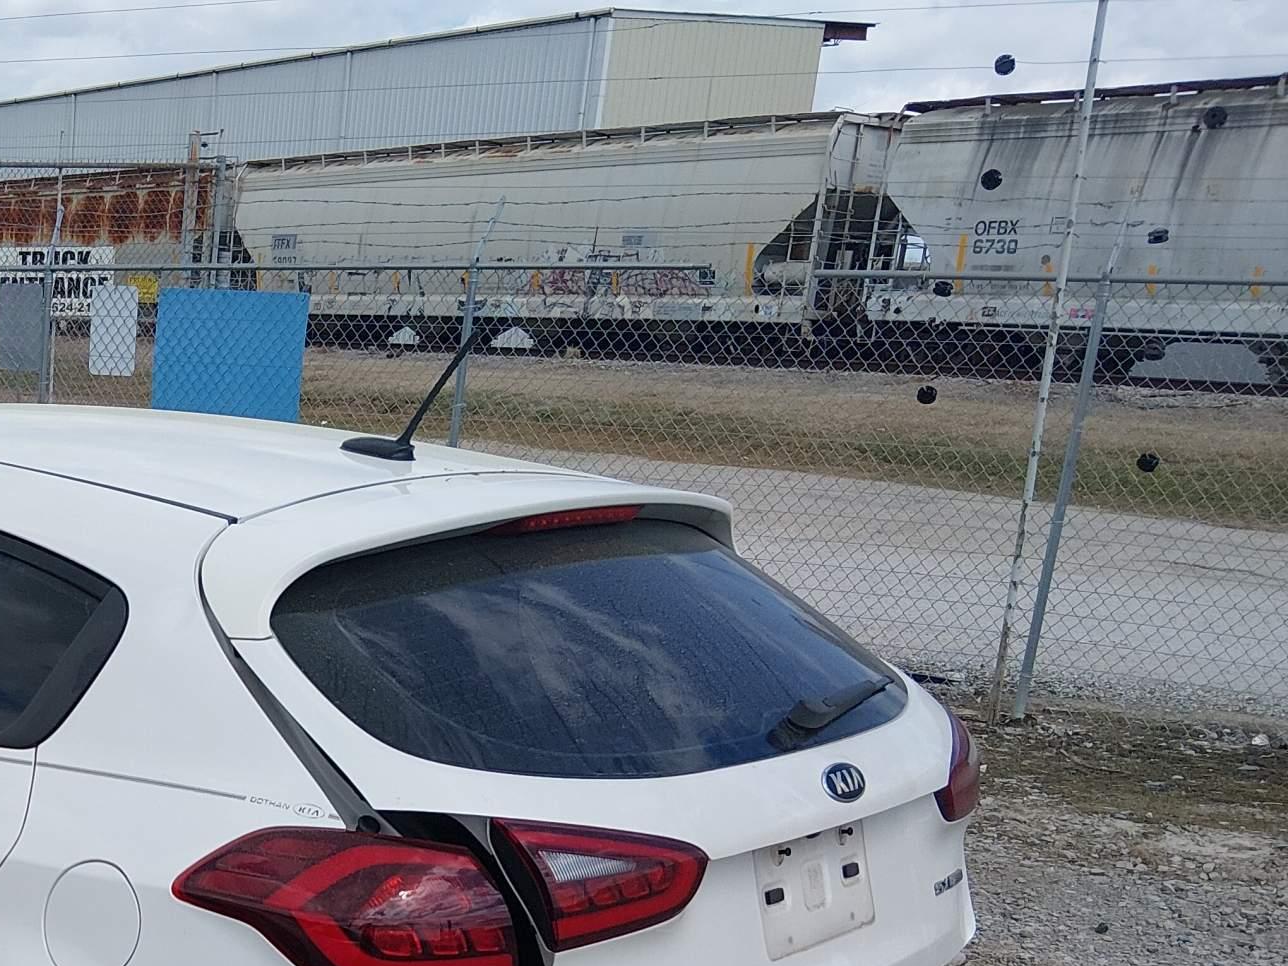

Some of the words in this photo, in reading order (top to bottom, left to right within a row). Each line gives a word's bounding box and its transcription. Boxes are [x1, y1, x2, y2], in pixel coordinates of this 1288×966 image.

[974, 219, 1020, 236] OFBX
[828, 767, 864, 795] KIA
[250, 796, 290, 810] DOTHAN
